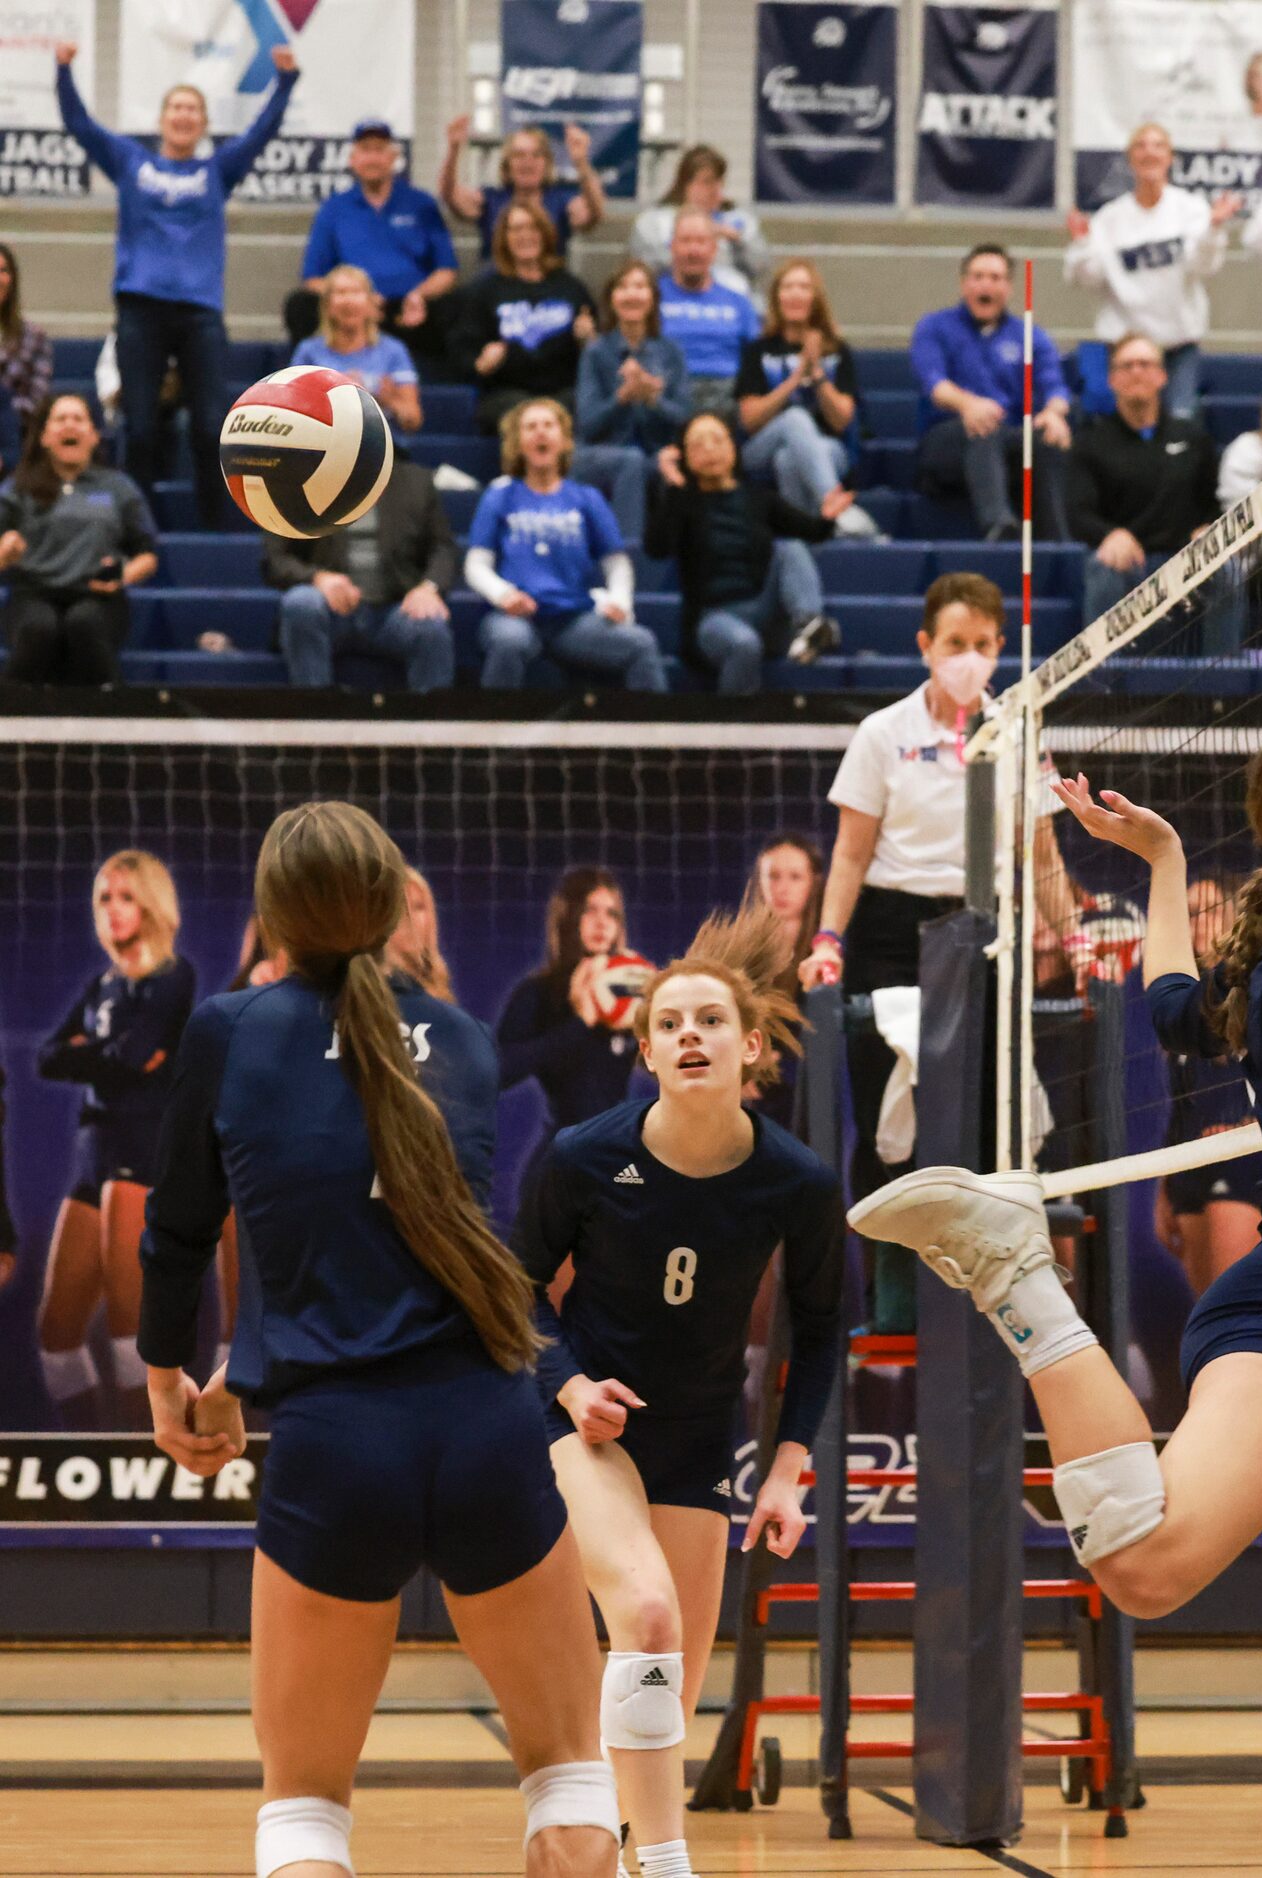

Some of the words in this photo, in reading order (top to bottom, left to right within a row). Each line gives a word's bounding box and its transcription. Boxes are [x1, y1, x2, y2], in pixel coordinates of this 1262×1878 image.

[920, 92, 1057, 140] ATTACK
[4, 132, 86, 167] JAGS
[1172, 154, 1259, 186] LADY
[227, 414, 294, 437] Baden
[663, 1247, 698, 1305] 8
